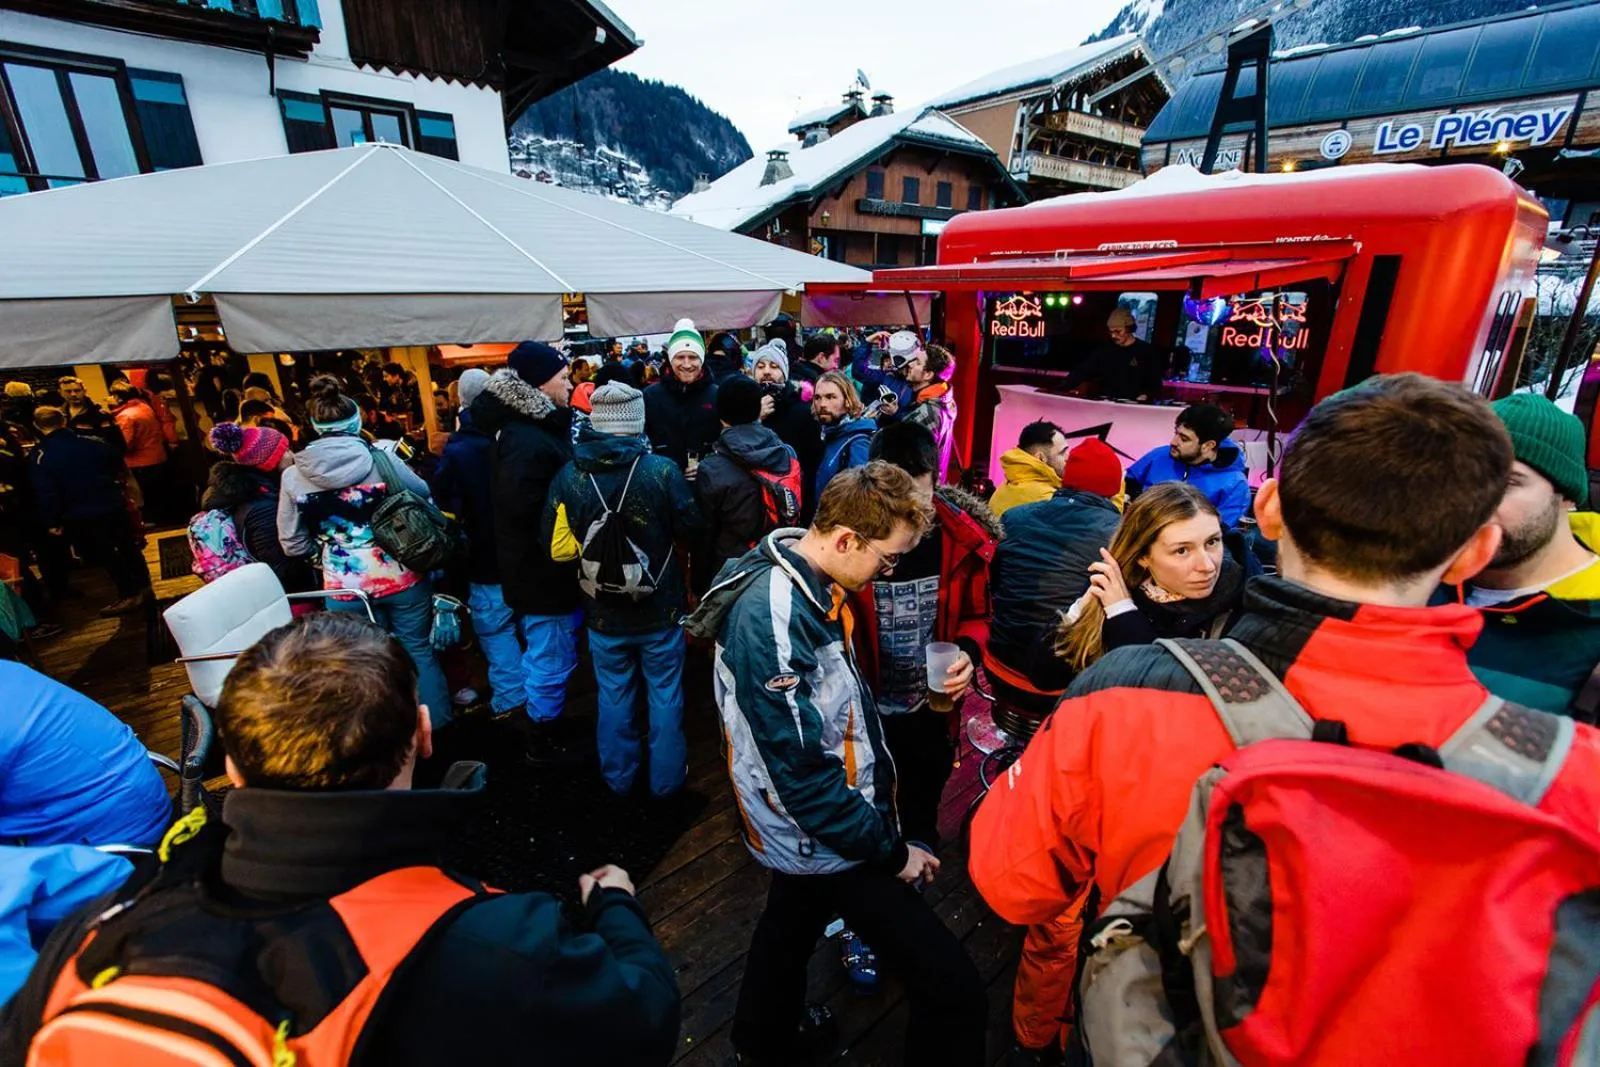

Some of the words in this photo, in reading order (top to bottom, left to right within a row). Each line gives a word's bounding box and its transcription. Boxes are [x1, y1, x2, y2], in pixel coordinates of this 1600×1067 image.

[1376, 124, 1421, 151] Le
[1434, 109, 1568, 146] Pléney
[991, 320, 1017, 336] Red
[1018, 320, 1045, 337] Bull
[1221, 326, 1263, 347] Red
